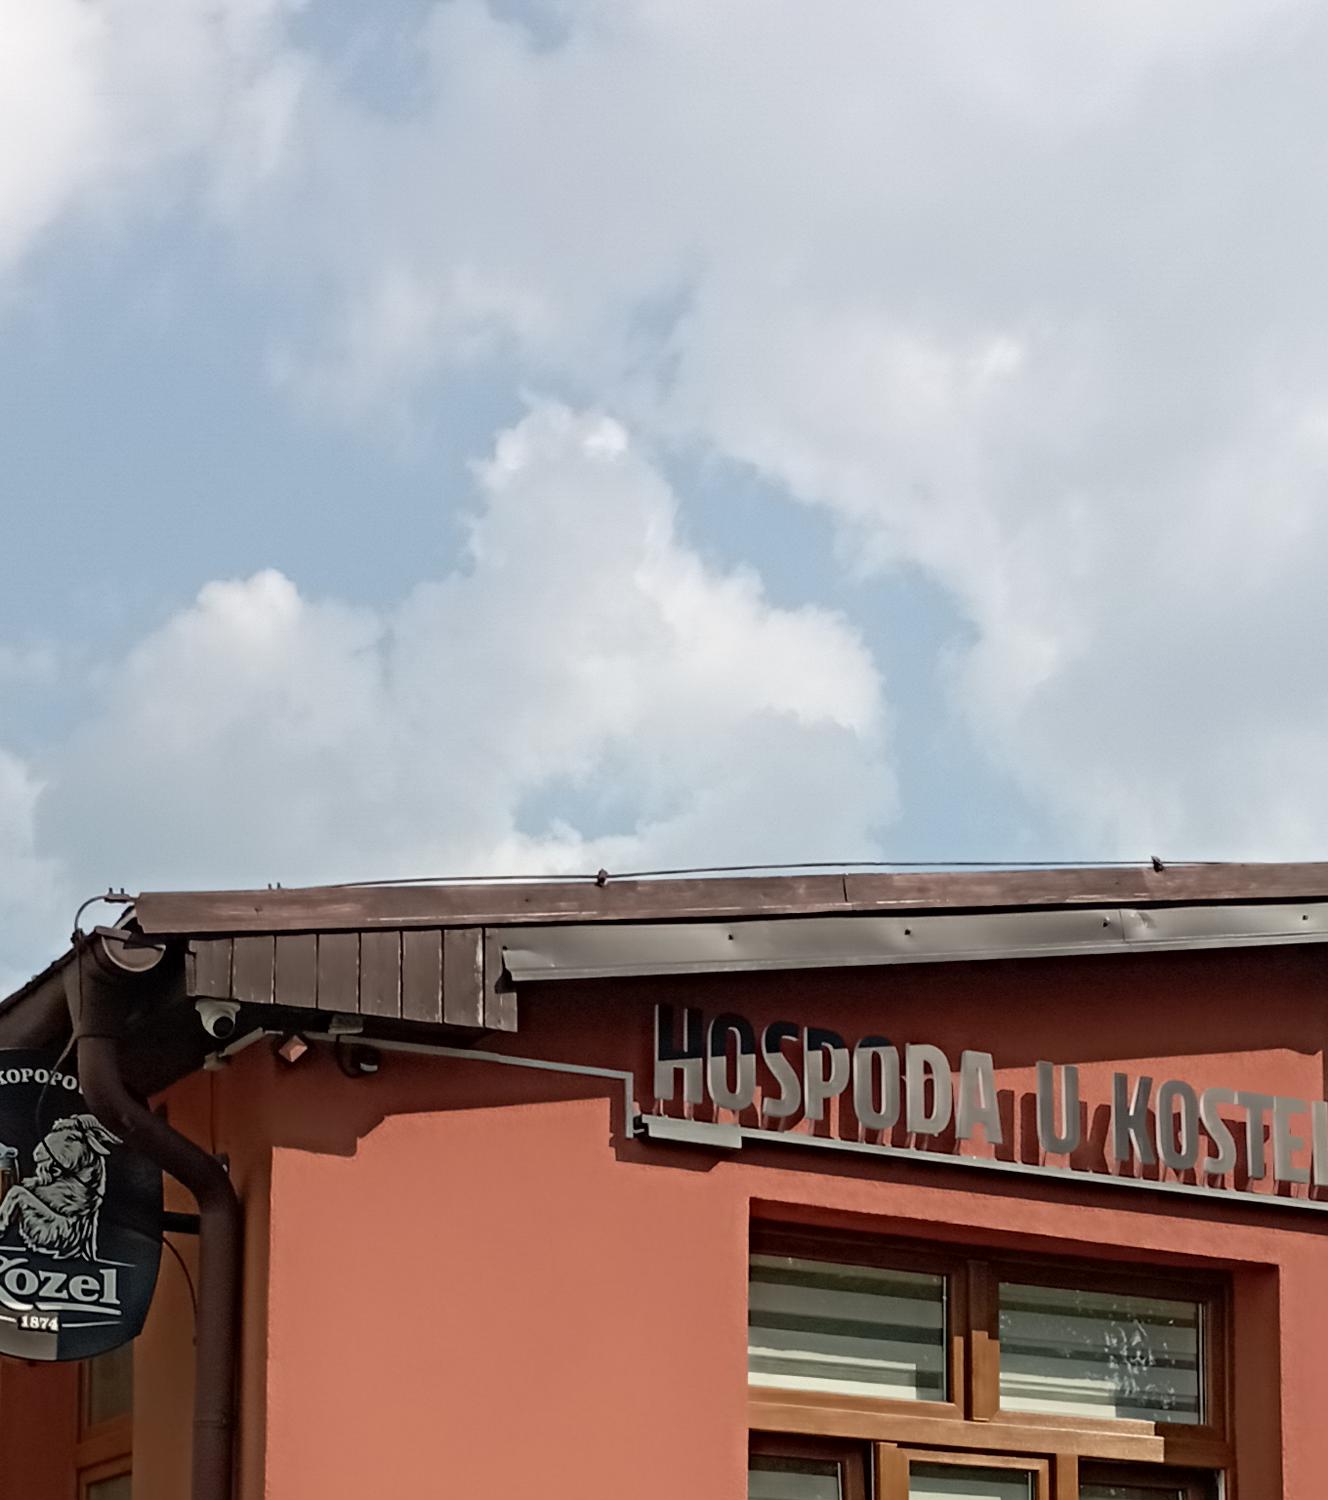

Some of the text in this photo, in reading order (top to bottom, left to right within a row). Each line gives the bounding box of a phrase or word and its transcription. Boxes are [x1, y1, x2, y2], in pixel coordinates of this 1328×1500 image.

[655, 1004, 1002, 1145] HOSPODA
[1036, 1061, 1079, 1154] U
[21, 1315, 59, 1331] 1874
